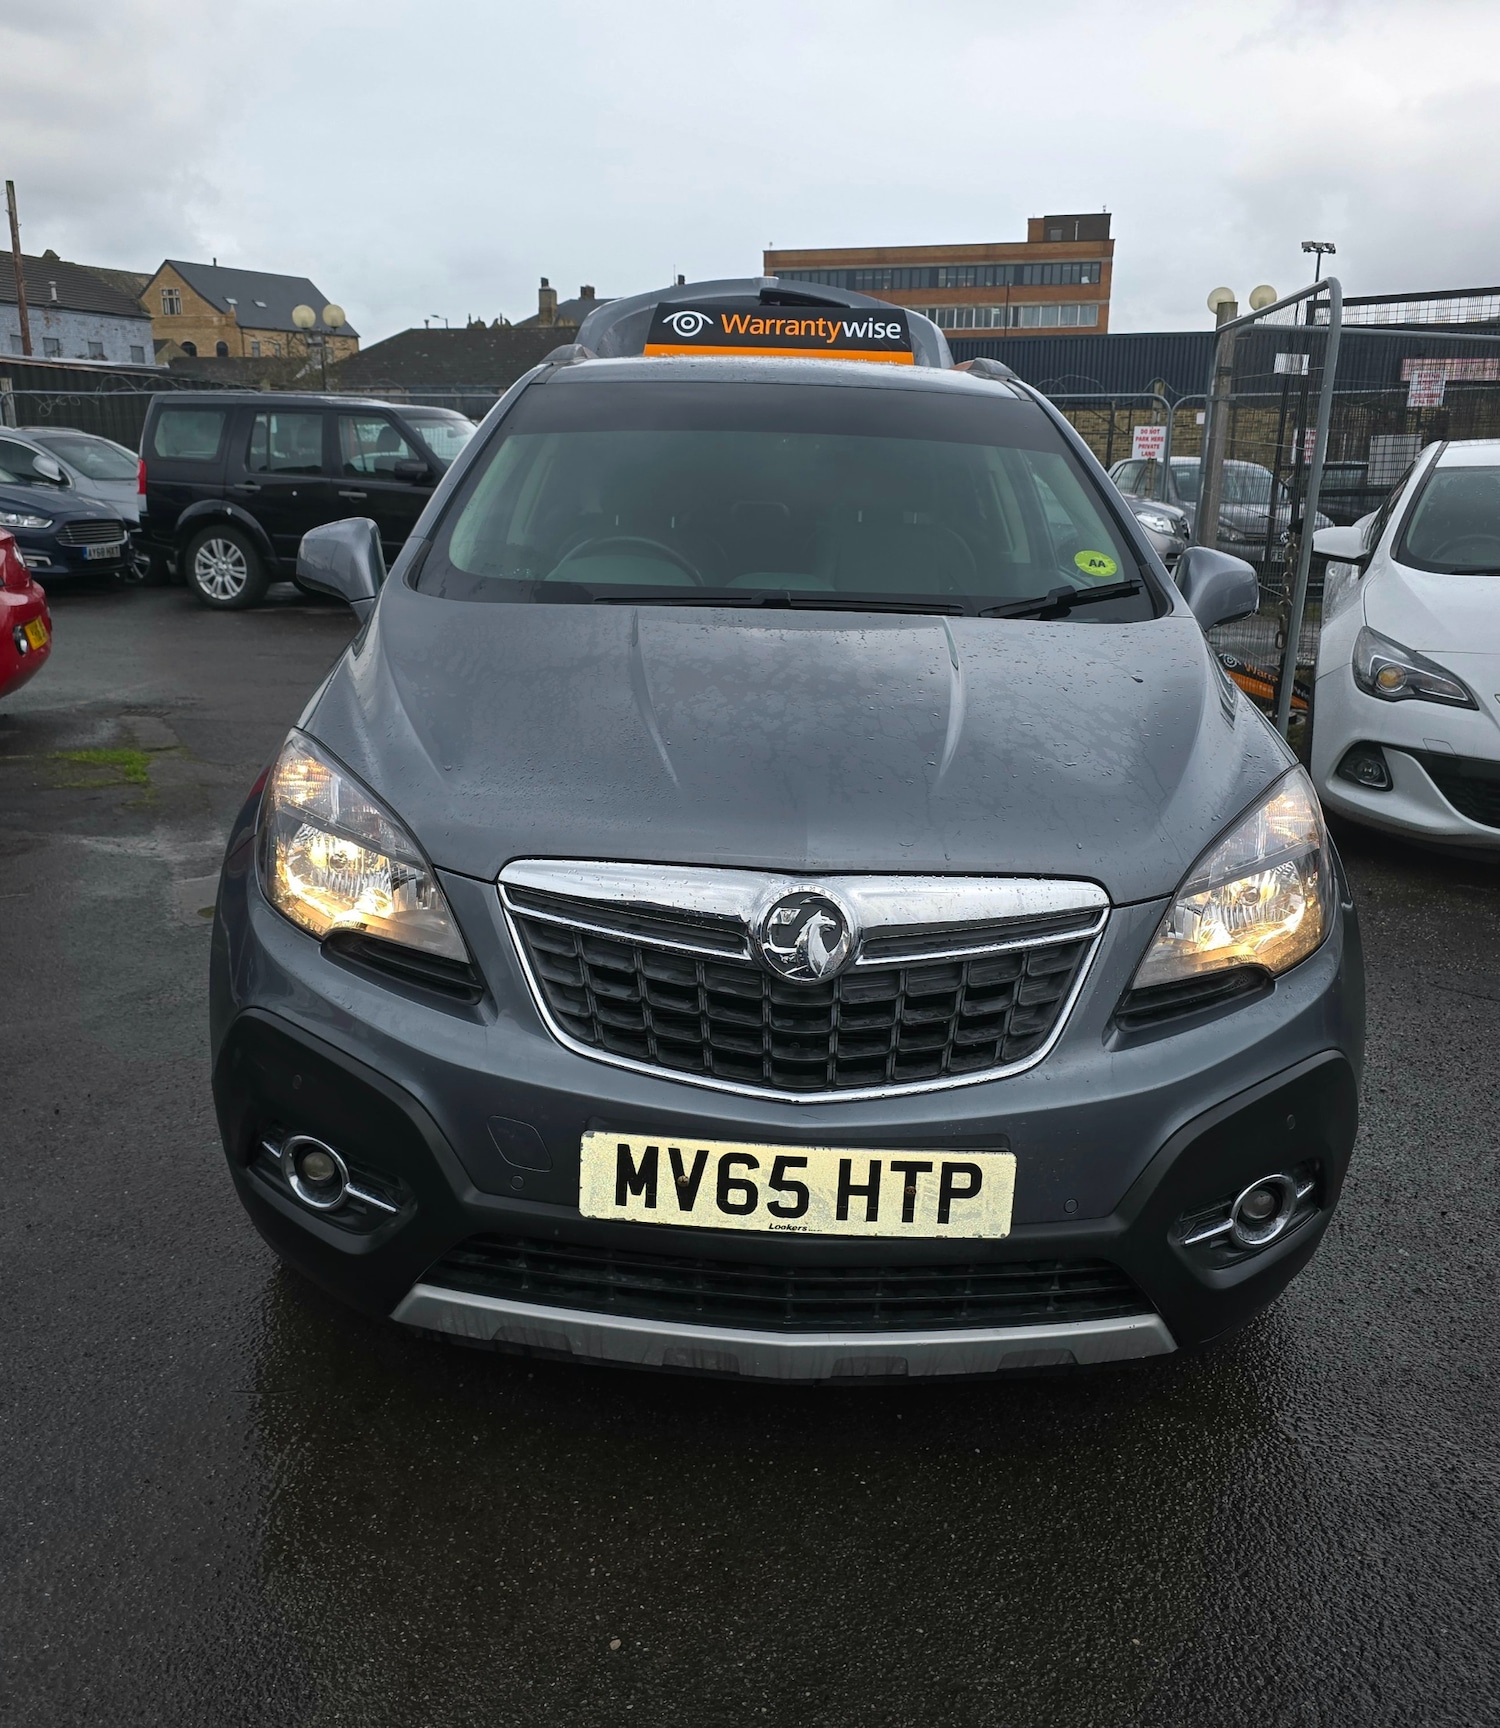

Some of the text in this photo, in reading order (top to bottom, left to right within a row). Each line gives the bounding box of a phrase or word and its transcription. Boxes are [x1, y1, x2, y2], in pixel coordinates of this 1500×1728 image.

[720, 313, 901, 343] Warrantywise
[1088, 559, 1106, 568] AA
[615, 1143, 983, 1224] MV65 HTP
[768, 1222, 808, 1232] Lookers
